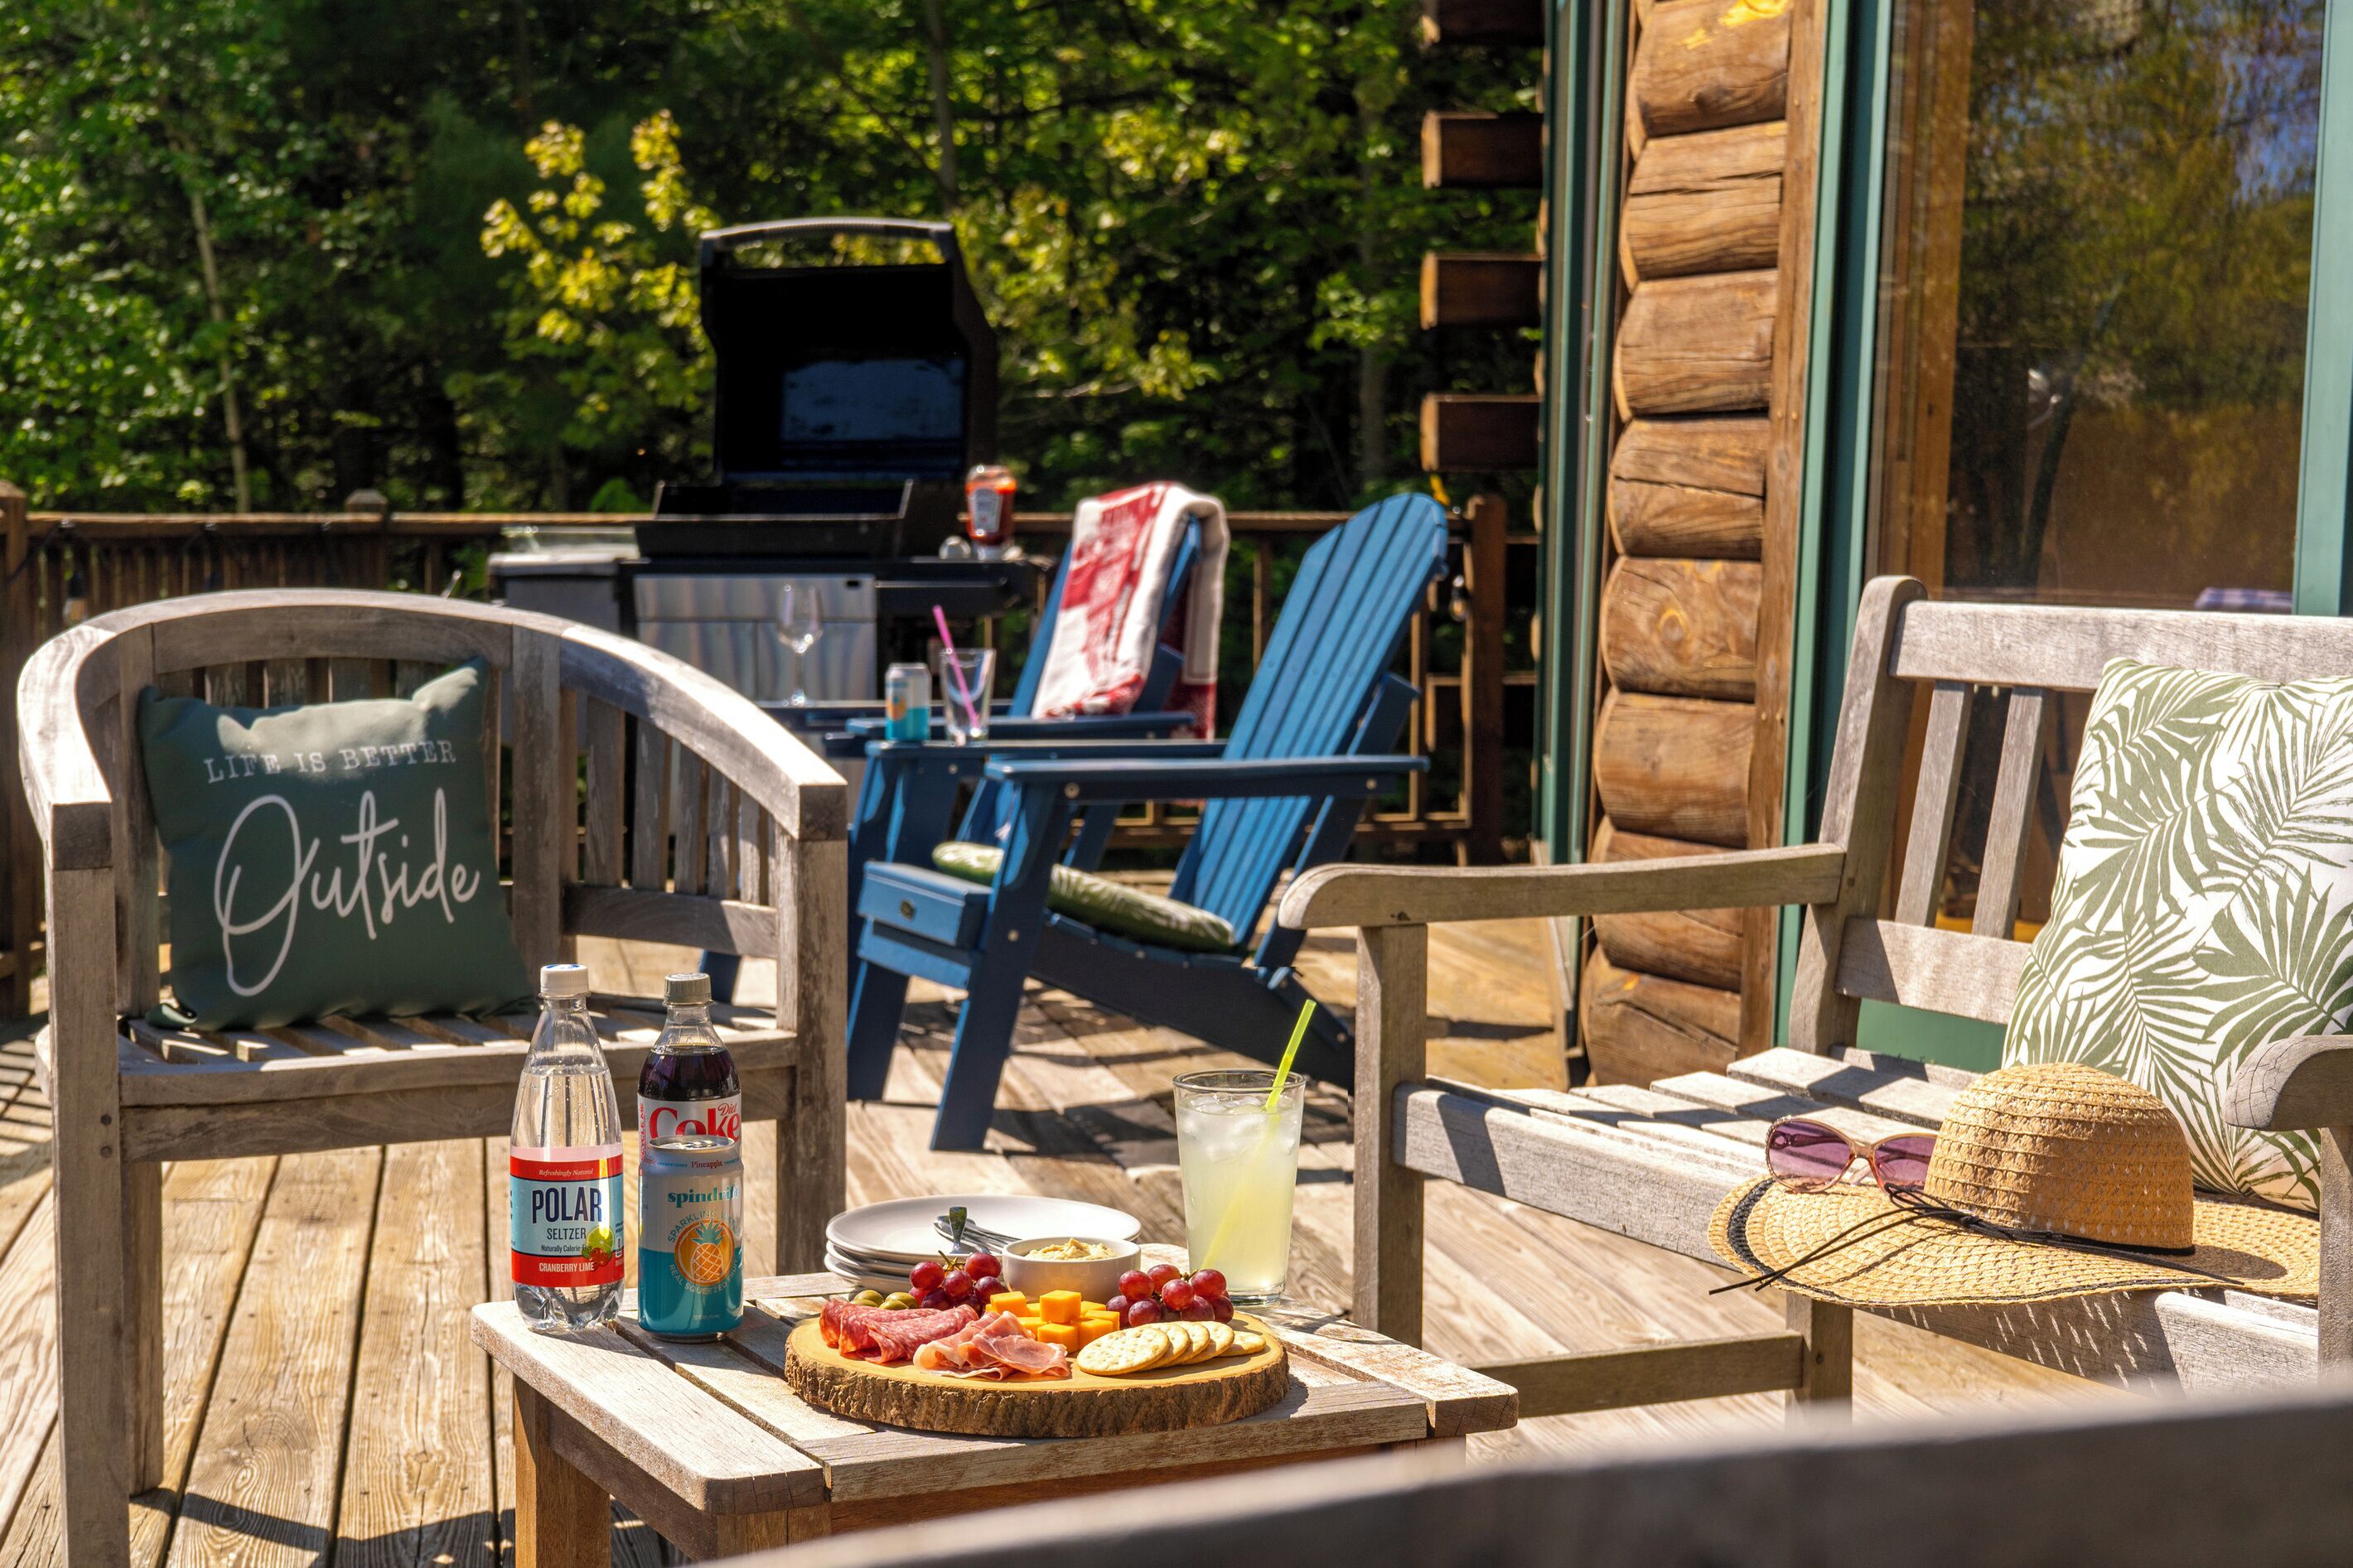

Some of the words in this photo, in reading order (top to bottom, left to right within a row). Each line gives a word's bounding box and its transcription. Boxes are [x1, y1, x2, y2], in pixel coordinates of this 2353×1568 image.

[204, 753, 282, 784] LIFE
[293, 751, 326, 773] IS
[339, 740, 456, 770] BETTER
[214, 788, 481, 996] Outside
[717, 1102, 737, 1117] Diet
[649, 1107, 740, 1141] Coke
[539, 1169, 572, 1177] Refreshingly
[573, 1168, 594, 1176] Natural
[691, 1160, 723, 1170] Pineapple
[532, 1186, 602, 1224] POLAR
[668, 1183, 739, 1209] spindrift
[547, 1228, 587, 1240] SELTZER
[667, 1209, 717, 1242] SPARKLING
[541, 1244, 563, 1253] Naturally
[563, 1244, 592, 1252] Calorie-Free
[539, 1262, 577, 1272] CRANBERRY
[579, 1262, 595, 1271] LIME
[669, 1264, 684, 1286] REAL
[684, 1282, 727, 1295] SQUEEZED
